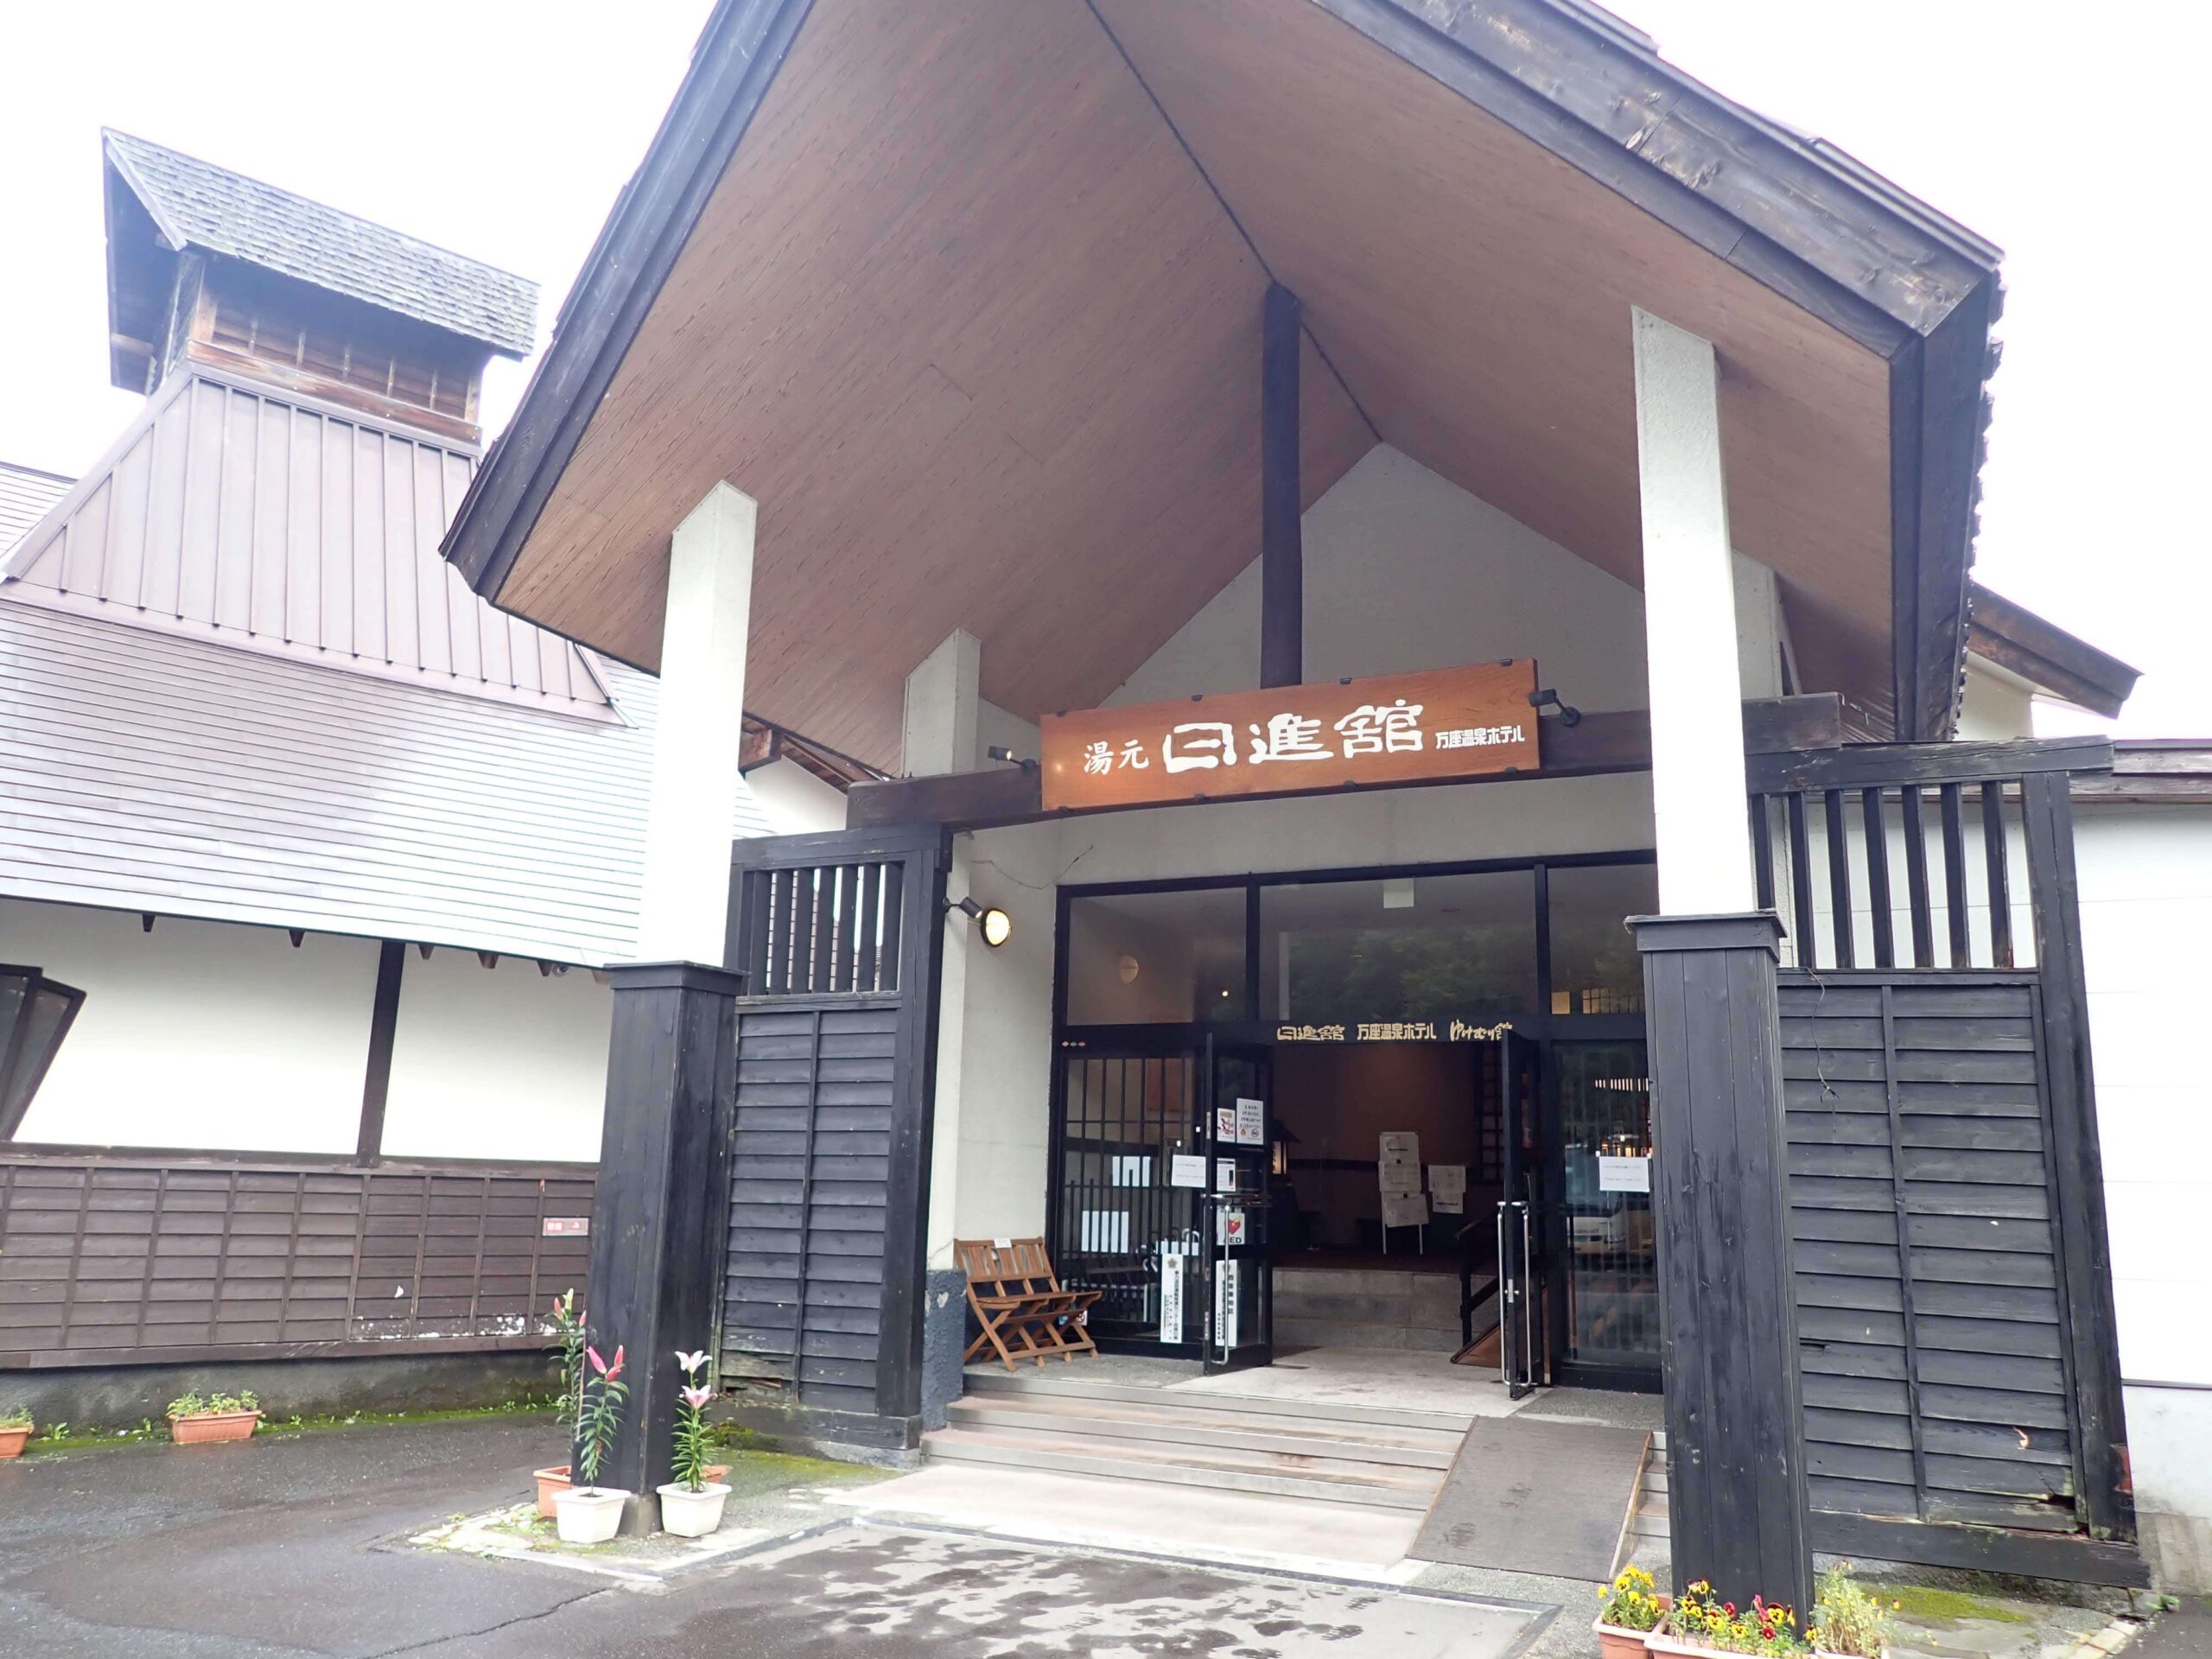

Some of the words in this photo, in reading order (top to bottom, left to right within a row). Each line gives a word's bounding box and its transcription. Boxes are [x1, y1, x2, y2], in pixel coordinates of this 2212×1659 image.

[1084, 739, 1149, 775] 湯元
[1435, 725, 1525, 750] 万座温泉ホテル
[1357, 1022, 1437, 1040] 万座温泉ホテル
